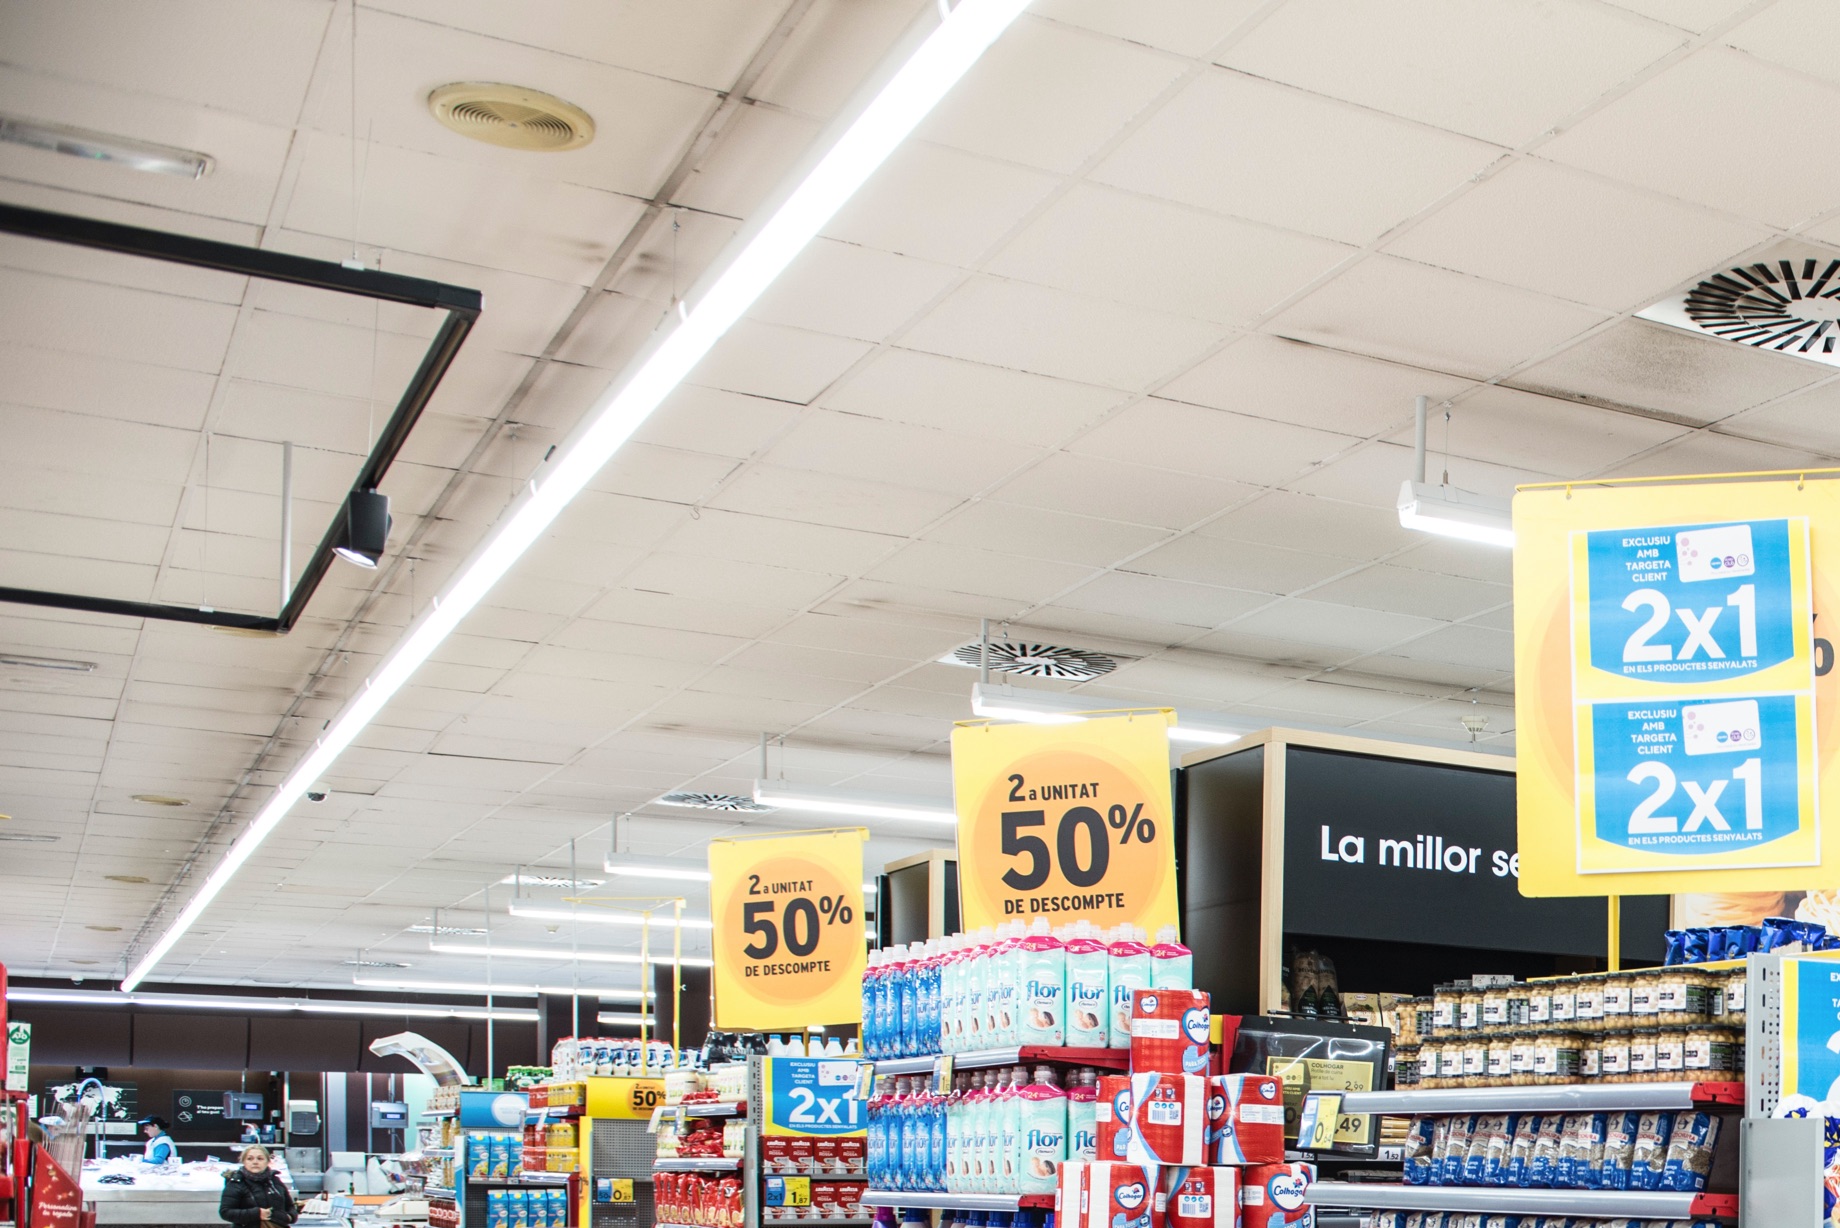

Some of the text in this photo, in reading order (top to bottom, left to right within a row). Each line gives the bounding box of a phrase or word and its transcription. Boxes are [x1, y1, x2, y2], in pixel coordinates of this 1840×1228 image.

[1622, 535, 1671, 548] EXCLUSIU
[1637, 549, 1659, 558] AMB
[1625, 560, 1671, 571] TARGETA
[1632, 572, 1667, 583] CLIENT
[1621, 584, 1758, 663] 2x1
[1623, 660, 1758, 673] EN ELS PRODUCTES SENYALATS
[1627, 709, 1677, 720] EXCLUSIU
[1642, 721, 1665, 731] AMB
[1631, 733, 1677, 743] TARGETA
[1637, 745, 1673, 755] CLIENT
[1041, 782, 1099, 801] UNITAT
[1626, 757, 1763, 834] 2x1
[1628, 832, 1763, 845] EN ELS PRODUCTES SENYALATS
[1001, 803, 1156, 891] 50%
[1321, 825, 1364, 864] La
[1379, 834, 1481, 874] millor
[771, 880, 813, 894] UNITAT
[1004, 893, 1125, 915] DE DESCOMPTE
[743, 894, 853, 960] 50%
[745, 960, 831, 977] DE DESCOMPTE
[1026, 980, 1061, 1001] flor
[1070, 982, 1105, 1003] flor
[633, 1090, 666, 1106] 50%
[788, 1087, 858, 1124] 2x1
[1027, 1130, 1063, 1151] flor
